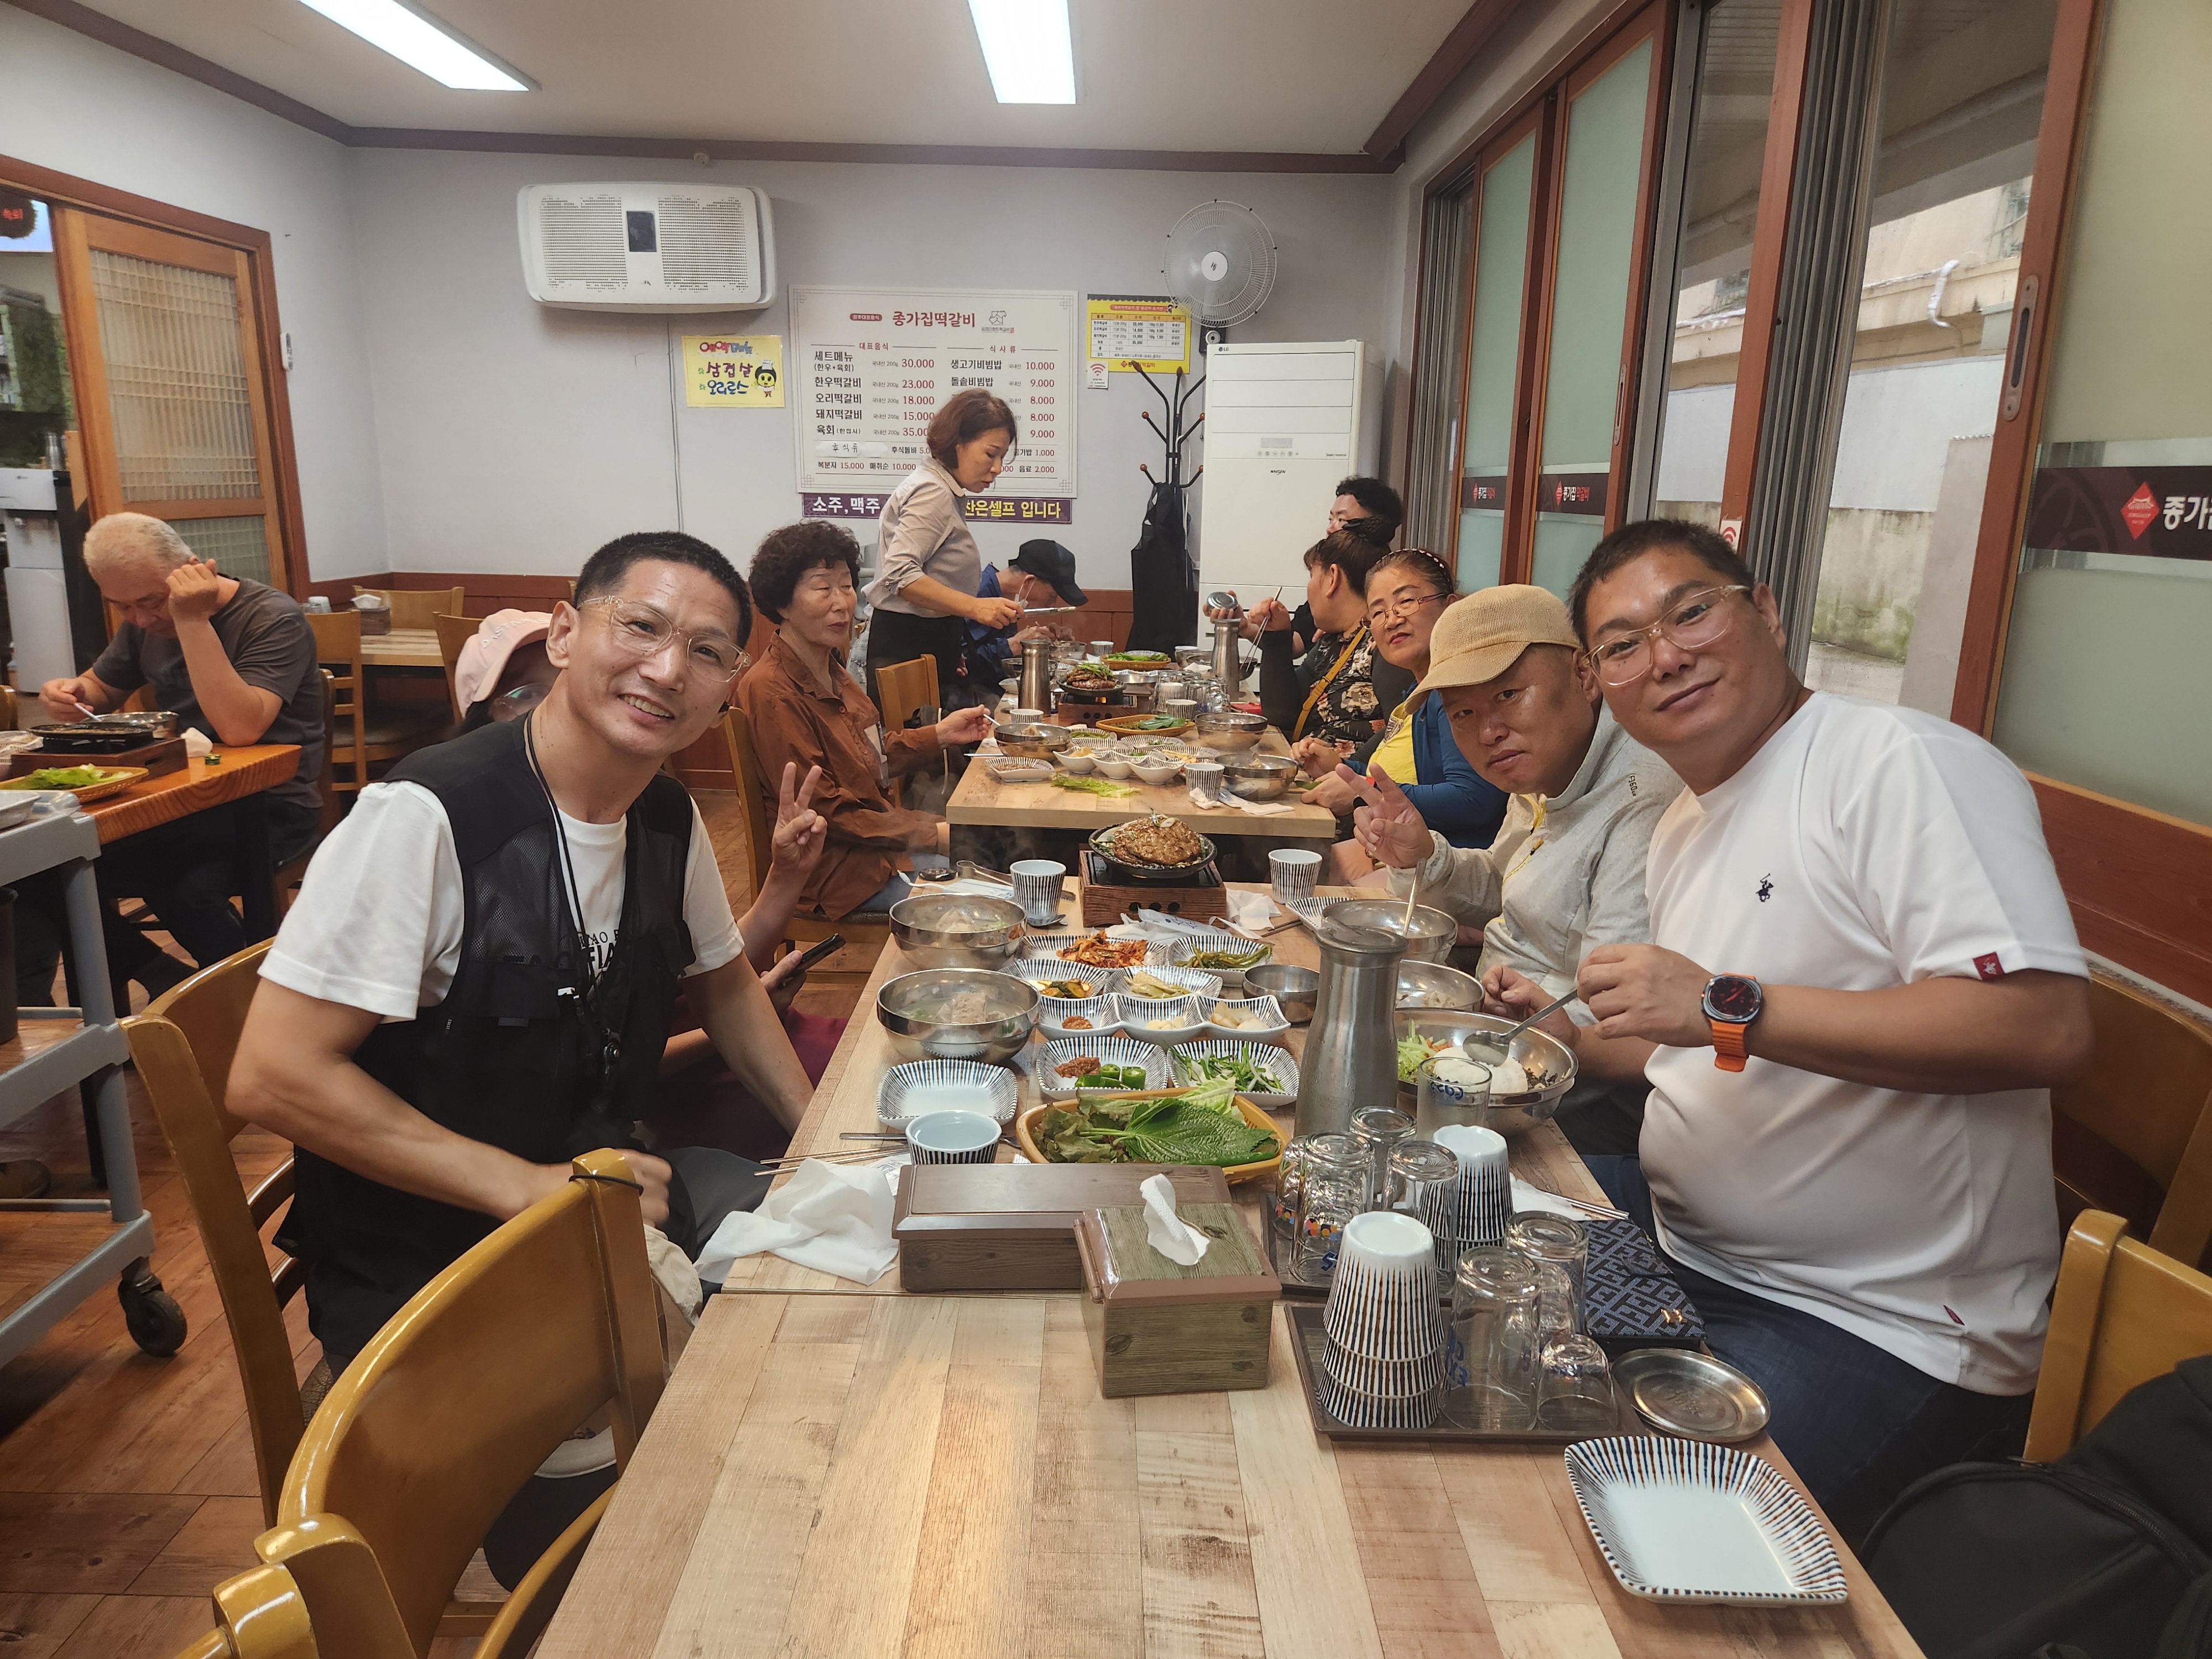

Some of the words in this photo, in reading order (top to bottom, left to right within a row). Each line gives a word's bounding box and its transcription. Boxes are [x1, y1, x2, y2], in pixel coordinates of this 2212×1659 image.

[893, 311, 975, 327] 종가집떡갈비
[815, 351, 853, 362] 세트메뉴
[814, 364, 854, 372] (한우+육회)
[951, 359, 1002, 370] 생고기비빔밥
[707, 379, 749, 395] 오리로스
[815, 377, 861, 388] 한우떡갈비
[951, 377, 994, 387] 돌솥비빔밥
[816, 393, 862, 404] 오리떡갈비
[816, 409, 862, 420] 돼지떡갈비
[817, 425, 834, 435] 육회
[1021, 502, 1061, 519] 입니다
[2163, 495, 2212, 531] 종가
